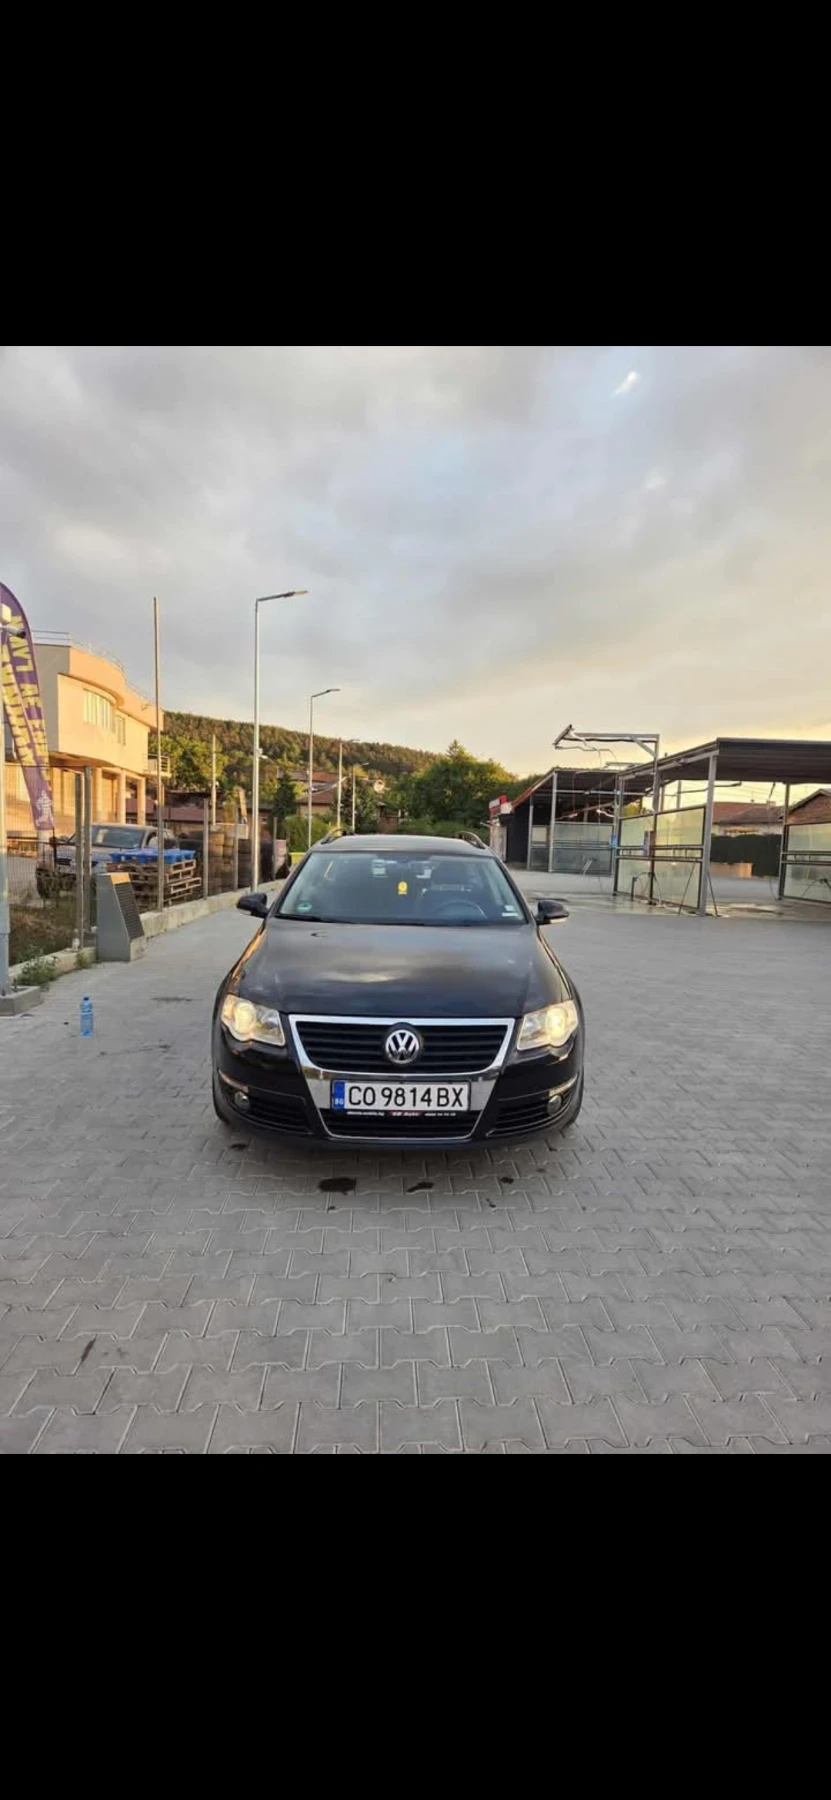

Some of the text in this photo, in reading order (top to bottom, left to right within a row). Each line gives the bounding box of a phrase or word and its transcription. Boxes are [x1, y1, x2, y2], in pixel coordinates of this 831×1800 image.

[385, 1029, 420, 1064] VW
[348, 1086, 376, 1106] CO
[381, 1087, 432, 1107] 9814
[436, 1087, 463, 1107] BX
